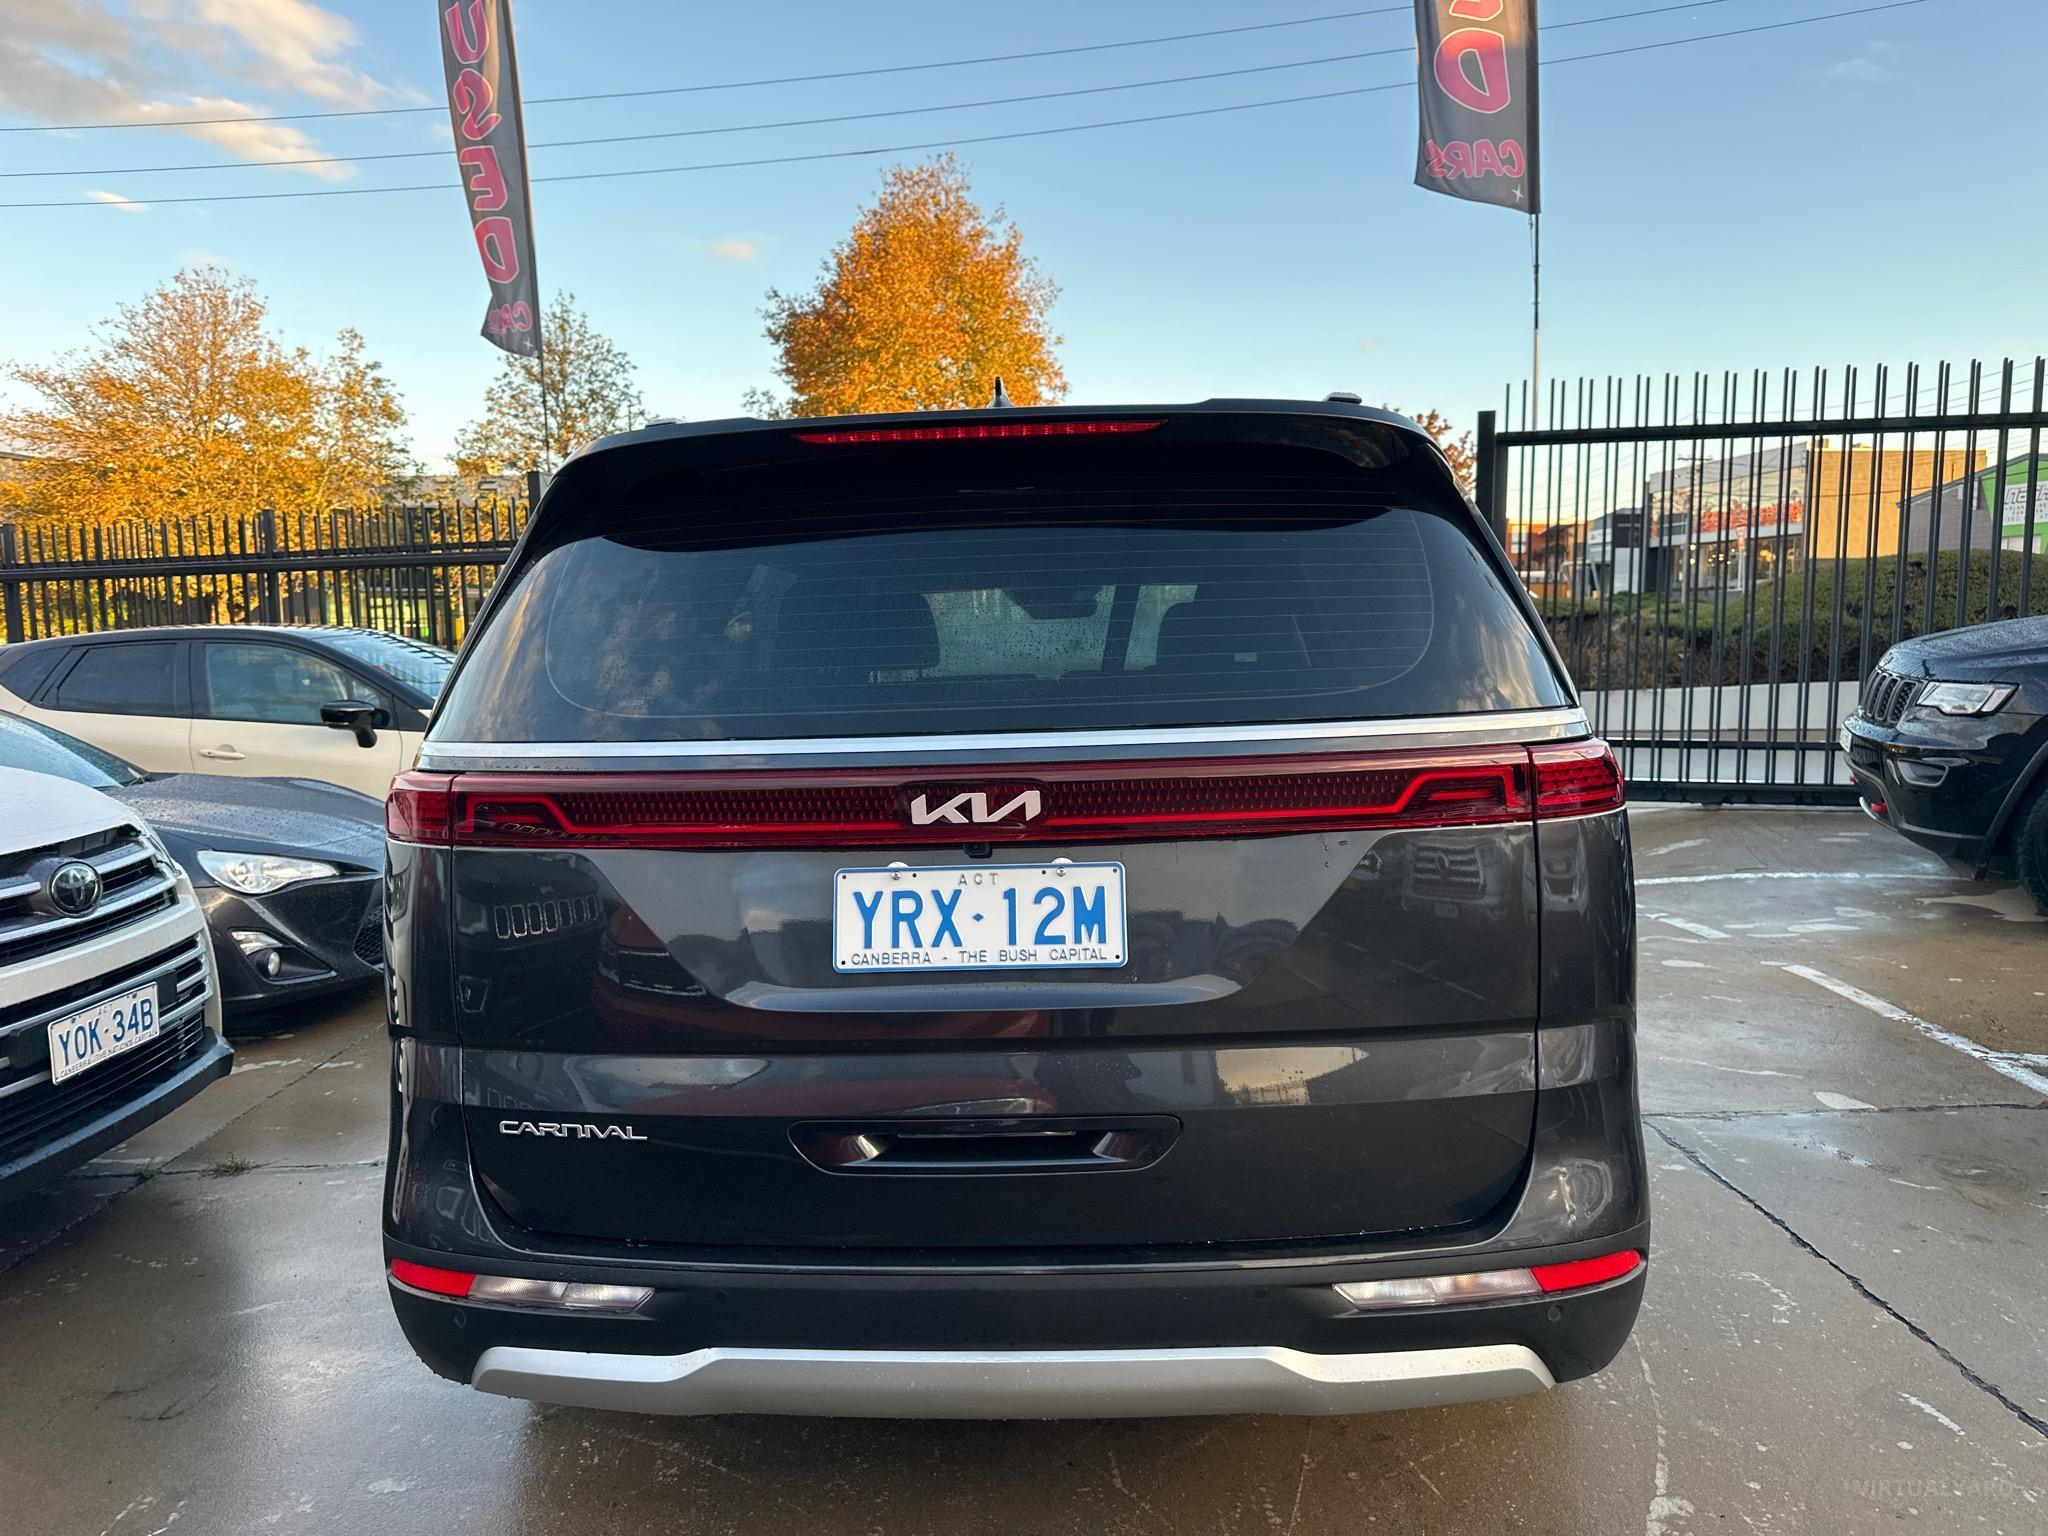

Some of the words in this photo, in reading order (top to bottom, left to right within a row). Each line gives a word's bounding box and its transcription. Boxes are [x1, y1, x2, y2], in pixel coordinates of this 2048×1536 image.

[911, 790, 1041, 825] KIA
[958, 873, 998, 886] ACT
[853, 888, 963, 949] YRX
[1003, 885, 1107, 946] 12M
[851, 950, 932, 966] CANBERRA
[959, 950, 988, 963] THE
[1000, 948, 1037, 962] BUSH
[1049, 947, 1107, 961] CAPITAL
[499, 1120, 648, 1139] CARNIVAL
